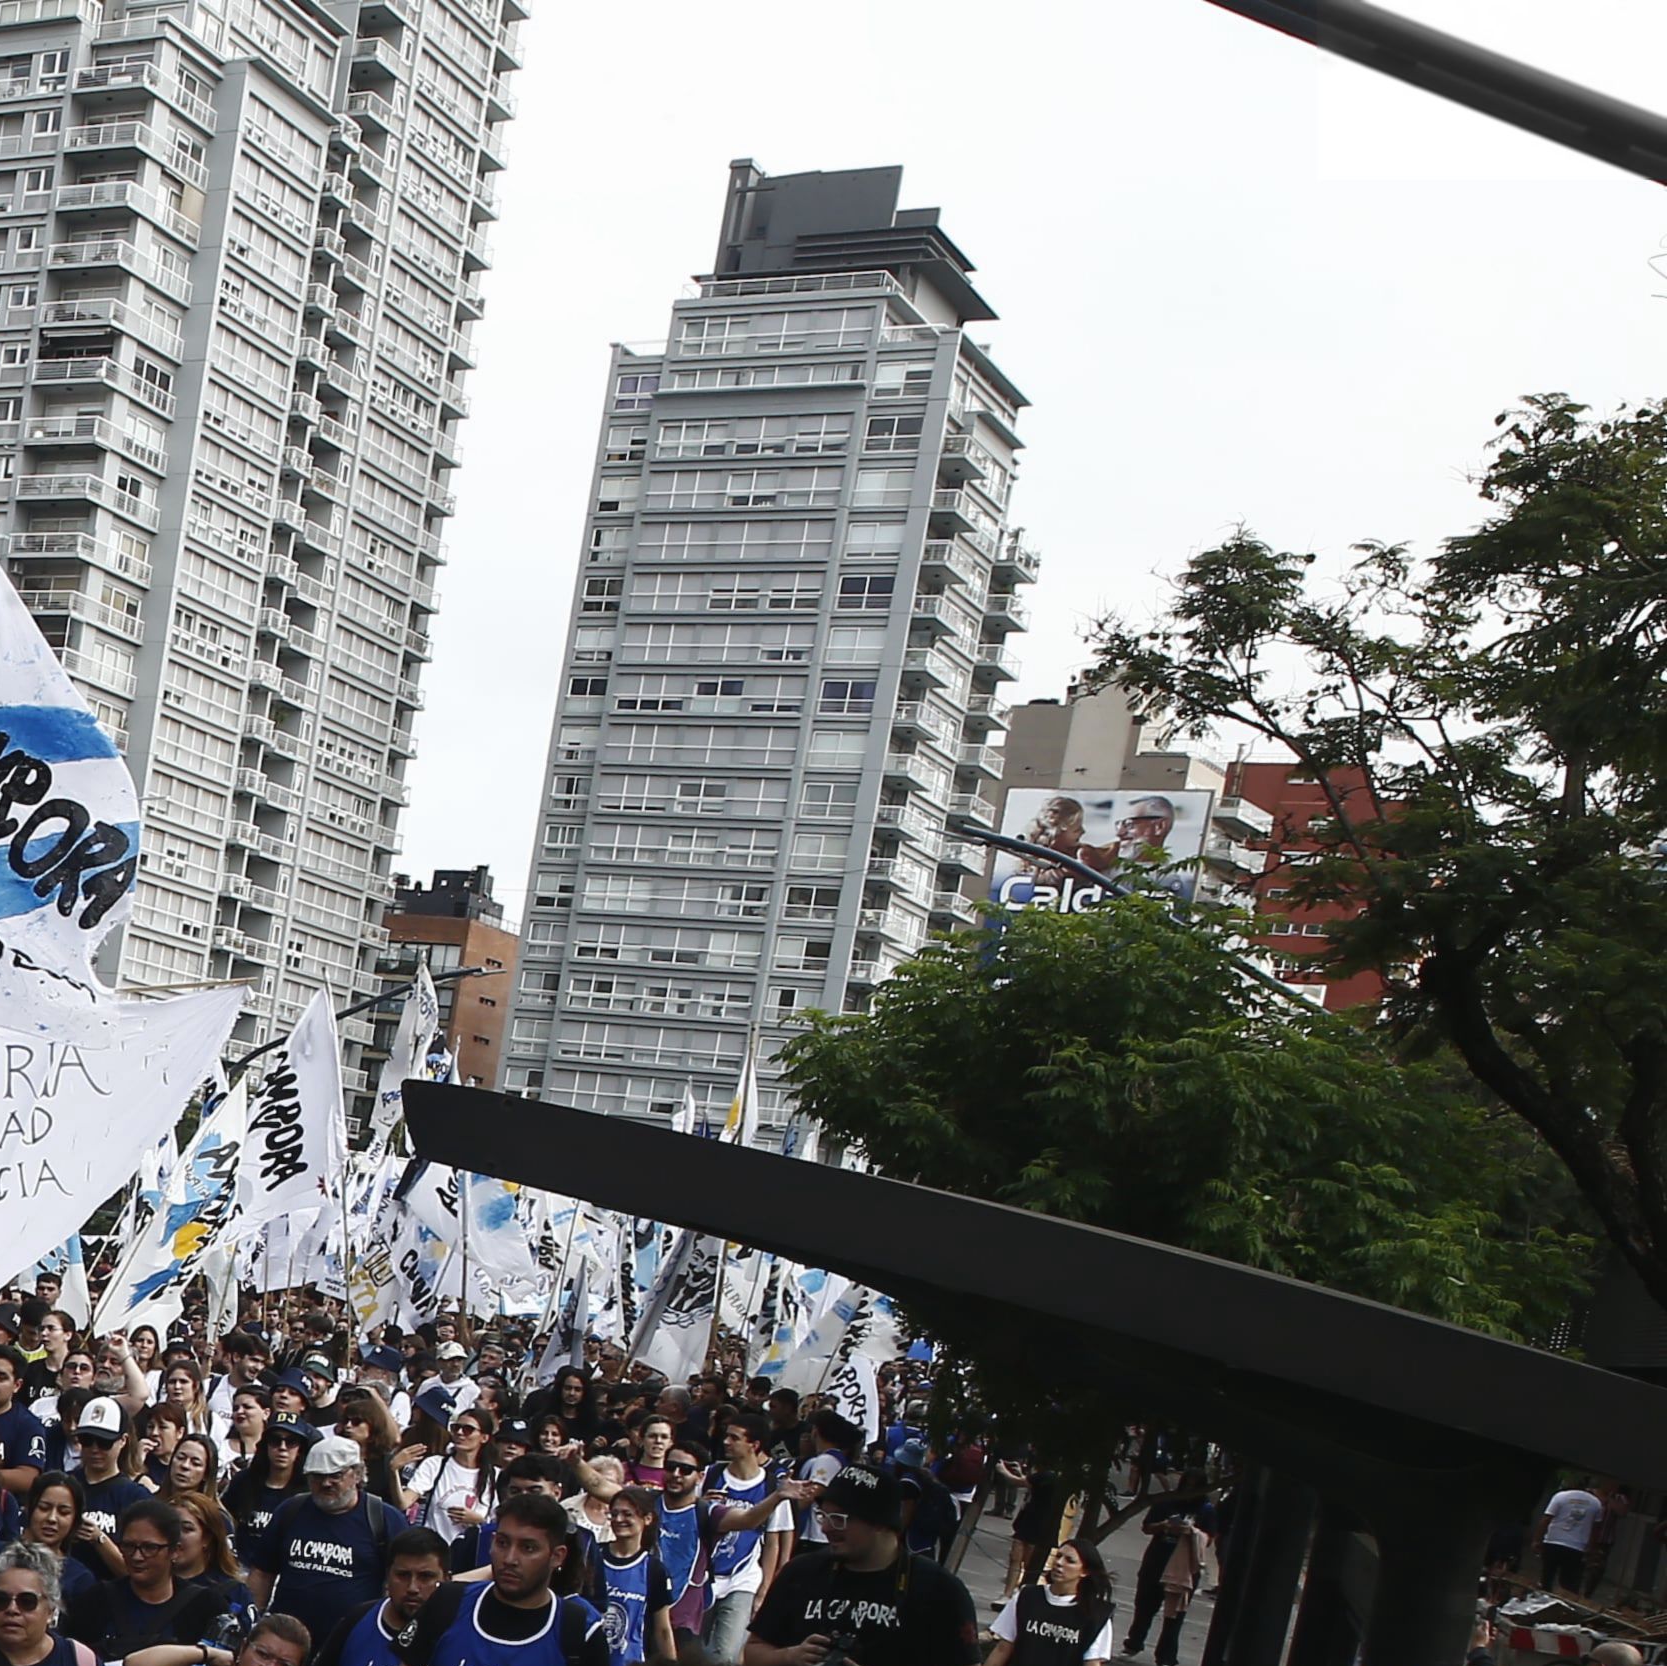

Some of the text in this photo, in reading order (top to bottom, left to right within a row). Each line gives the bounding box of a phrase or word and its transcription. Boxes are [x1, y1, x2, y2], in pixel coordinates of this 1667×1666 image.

[290, 1538, 353, 1565] LA CAMPORA
[804, 1600, 822, 1620] LA
[1026, 1620, 1080, 1645] LA CAMPORA
